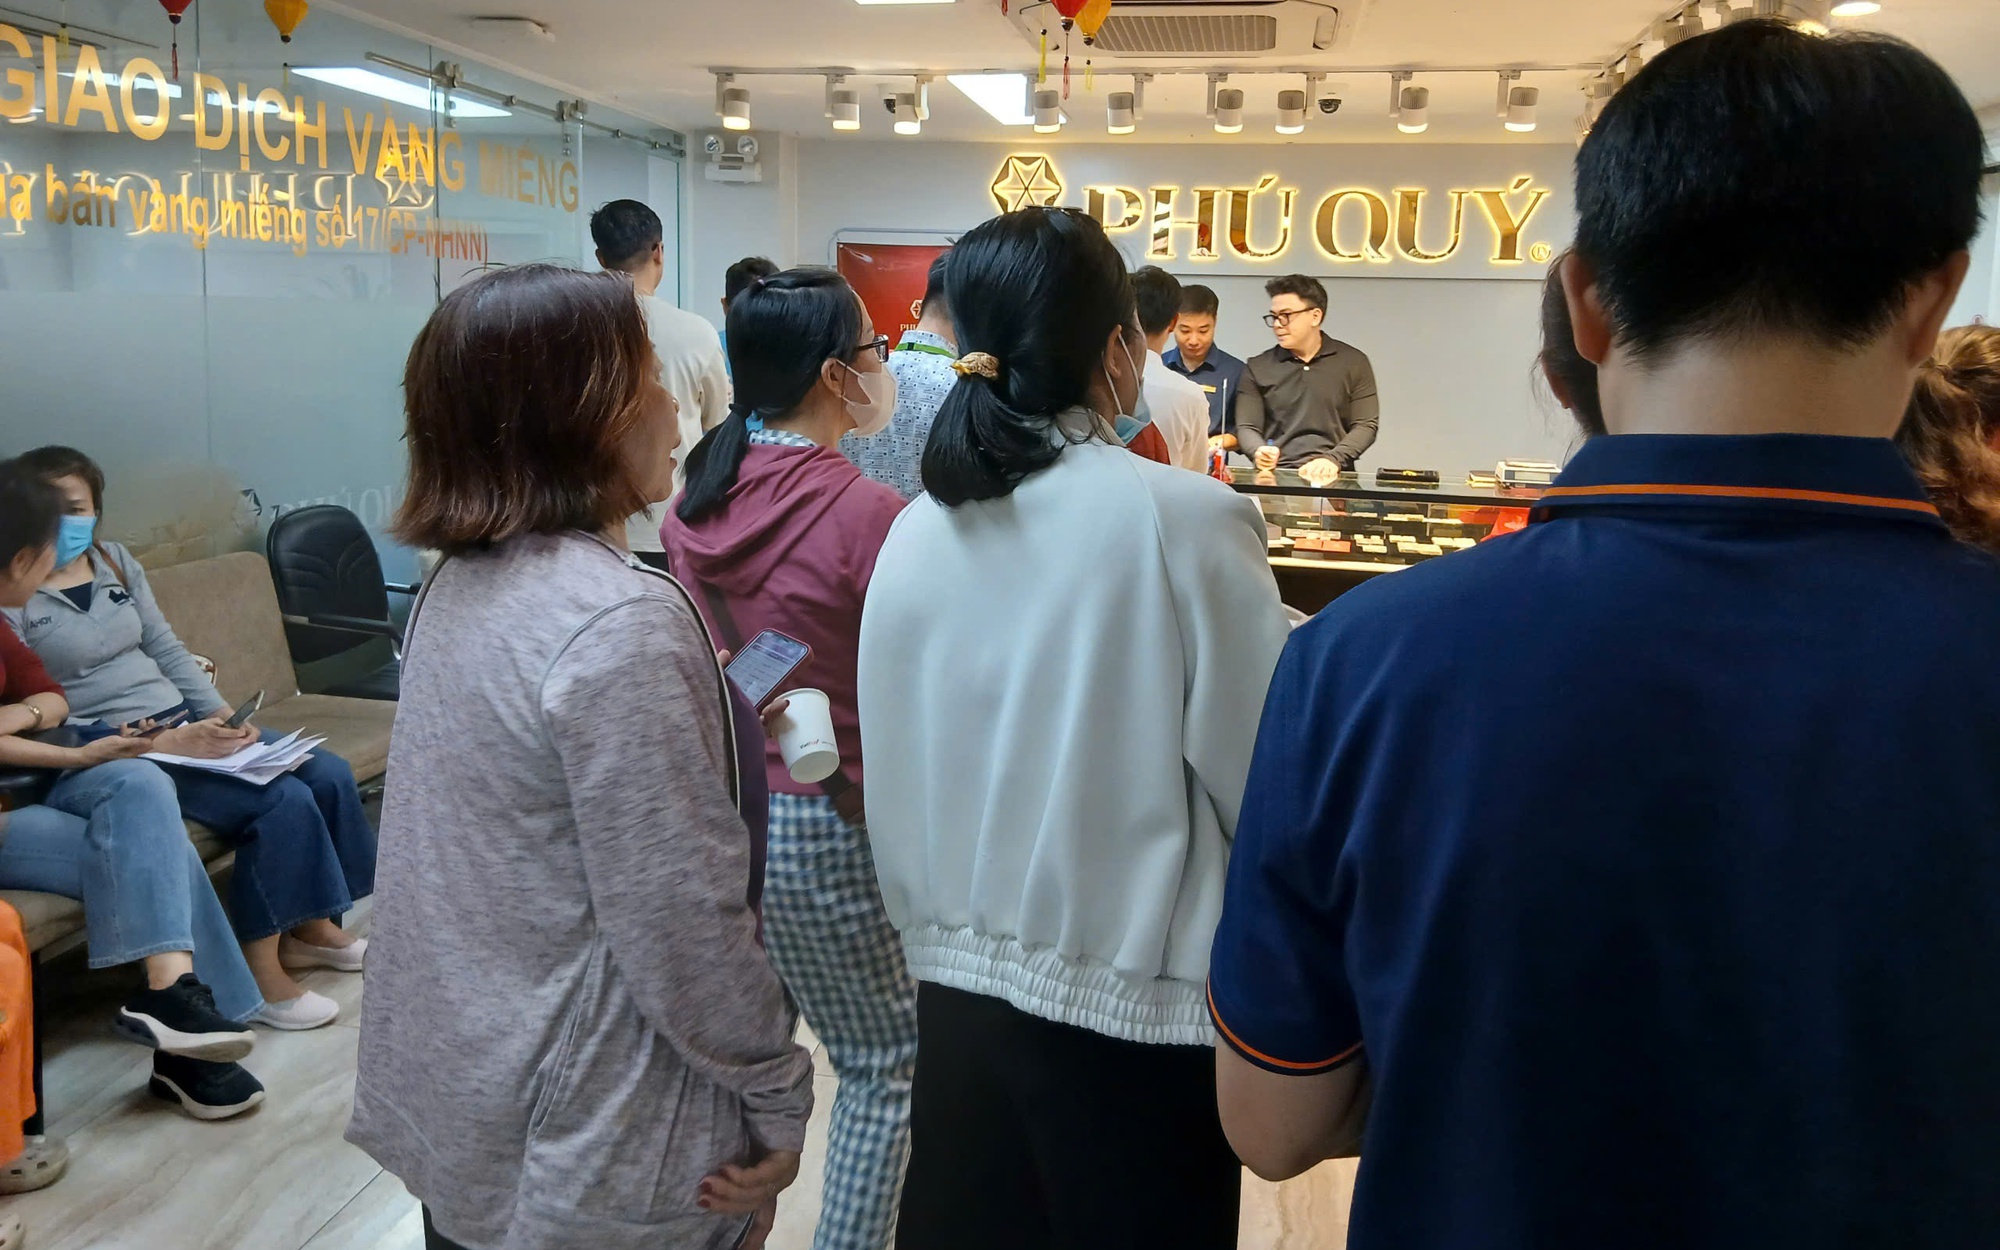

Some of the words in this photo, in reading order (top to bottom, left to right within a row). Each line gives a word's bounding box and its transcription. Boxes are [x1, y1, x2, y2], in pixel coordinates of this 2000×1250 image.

[0, 24, 170, 140] GIAO
[193, 72, 327, 171] DỊCH
[344, 103, 465, 191] VÀNG
[128, 178, 209, 249] vàng
[221, 183, 306, 257] miếng
[315, 194, 346, 249] số
[1083, 176, 1298, 260] PHÚ
[1314, 177, 1550, 262] QUÝ
